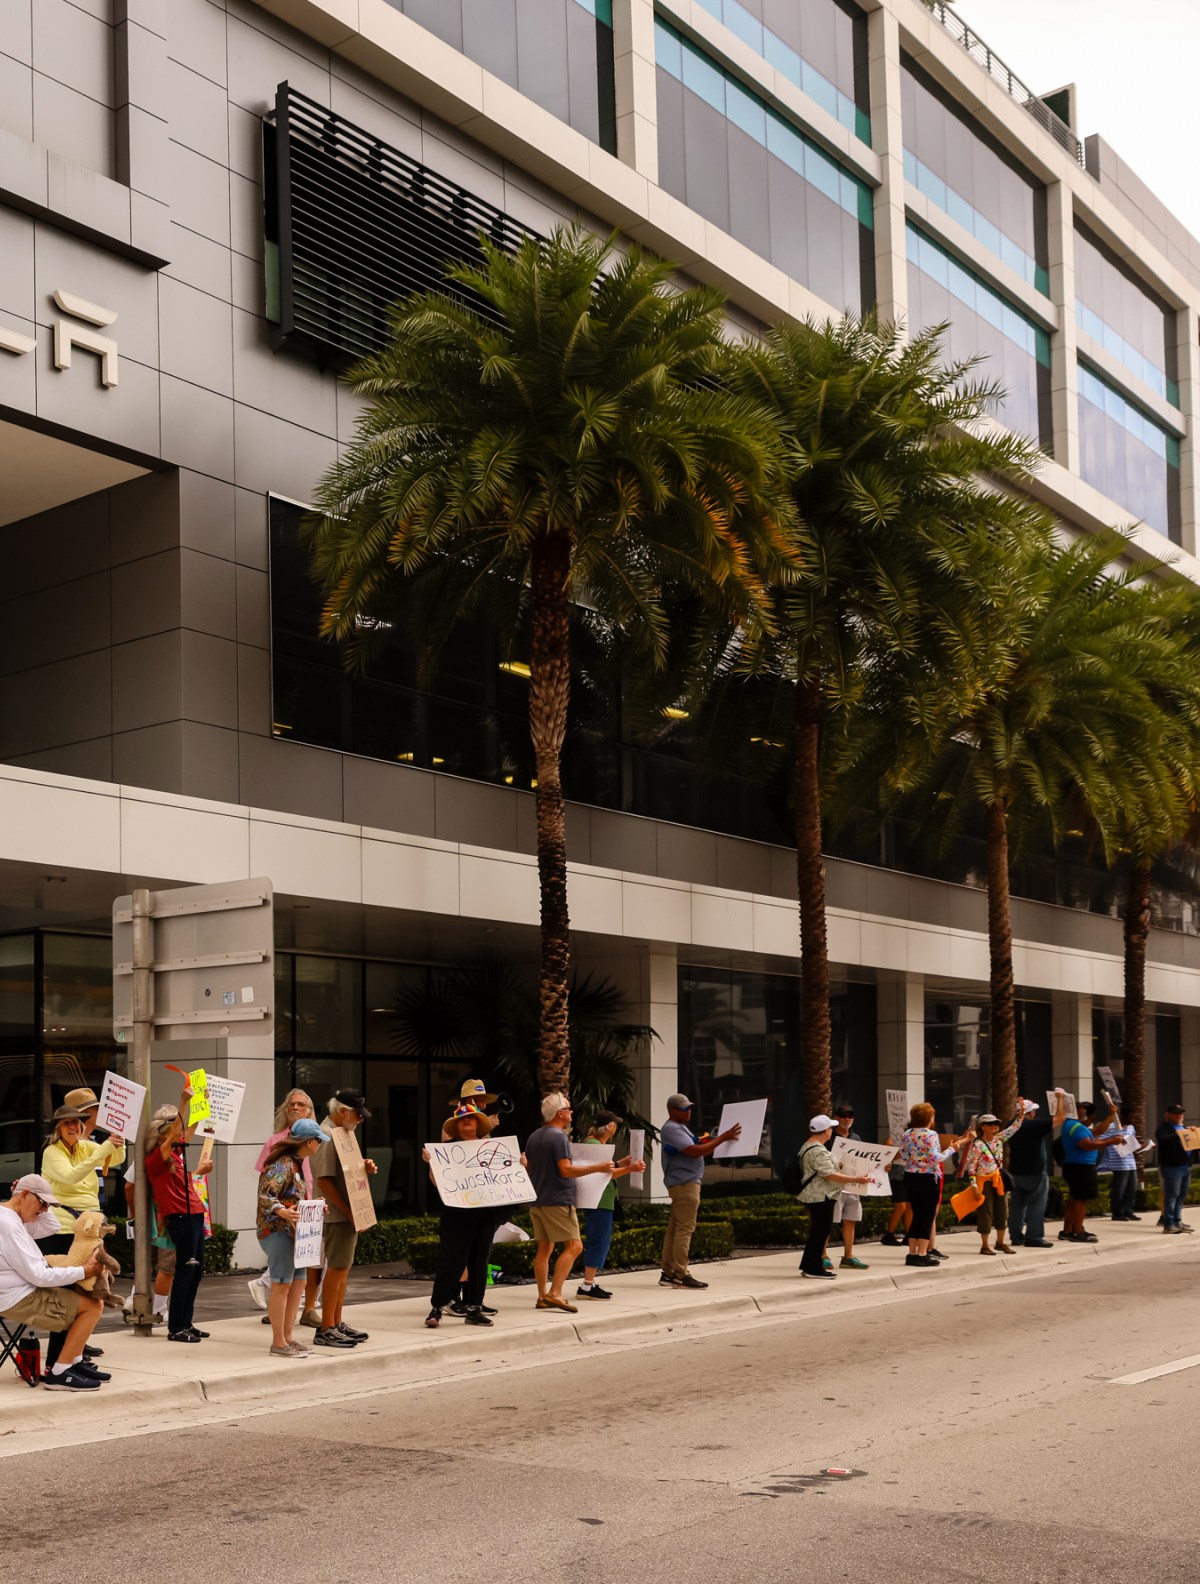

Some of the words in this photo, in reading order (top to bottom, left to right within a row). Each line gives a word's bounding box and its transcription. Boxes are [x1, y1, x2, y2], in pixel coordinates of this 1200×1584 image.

[107, 1087, 128, 1100] Oligarch
[108, 1079, 135, 1095] Dangerous
[104, 1103, 131, 1119] Everything
[434, 1145, 466, 1165] NO
[442, 1167, 526, 1194] Swastikars
